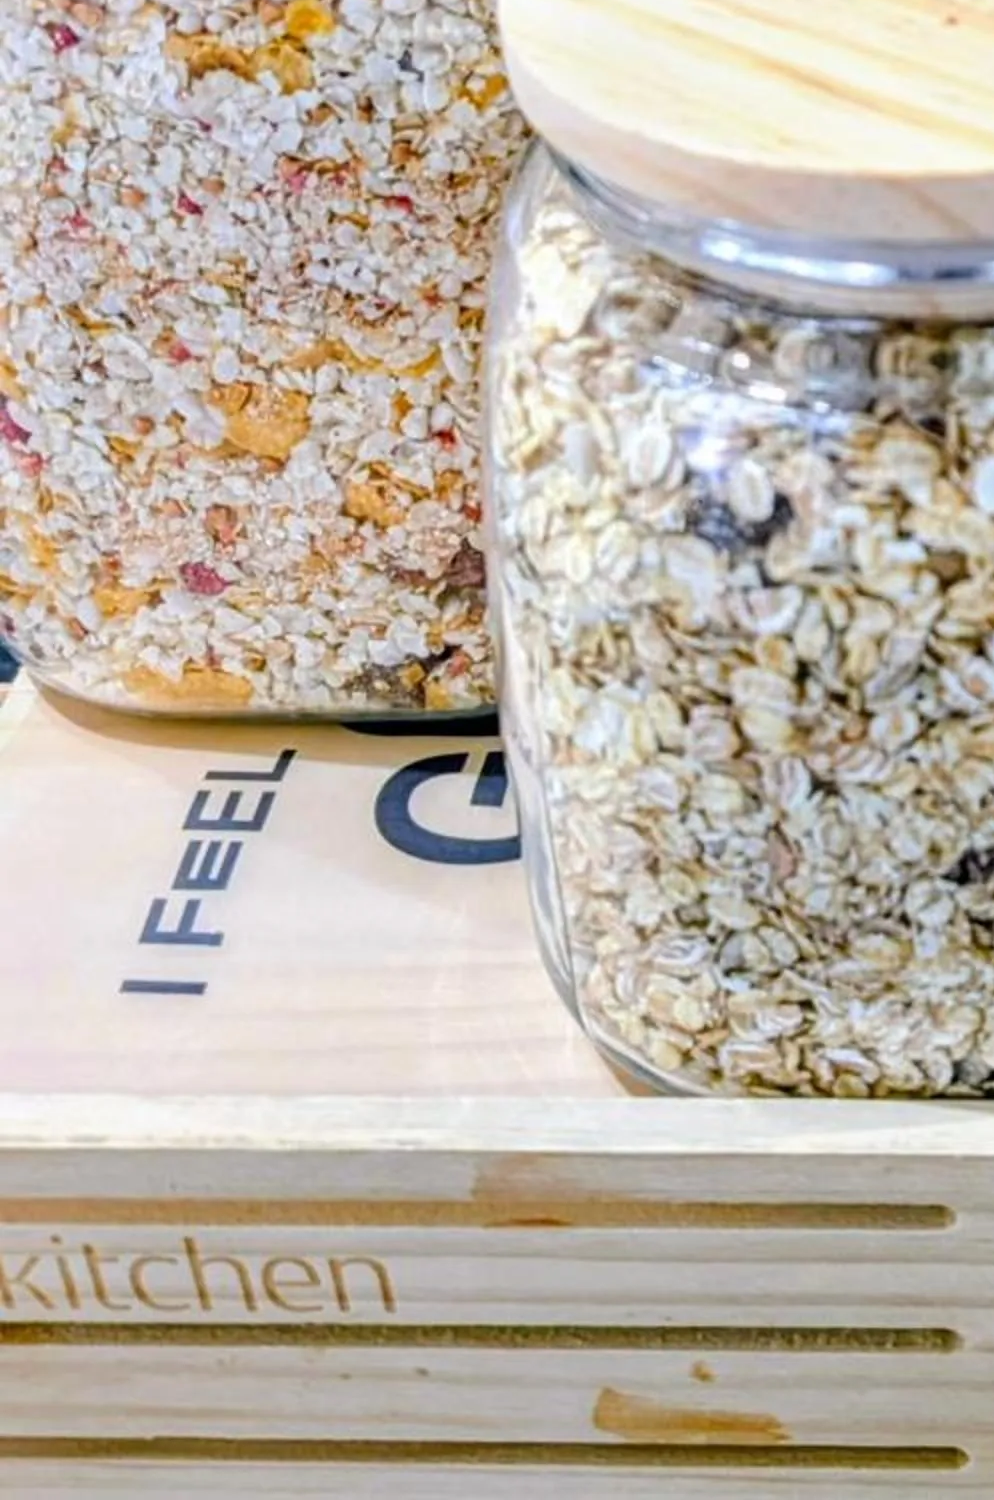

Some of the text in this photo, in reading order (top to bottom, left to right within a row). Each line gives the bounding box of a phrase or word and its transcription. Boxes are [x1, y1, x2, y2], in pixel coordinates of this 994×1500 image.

[119, 749, 298, 996] I FEEL
[0, 1234, 397, 1314] kitchen
